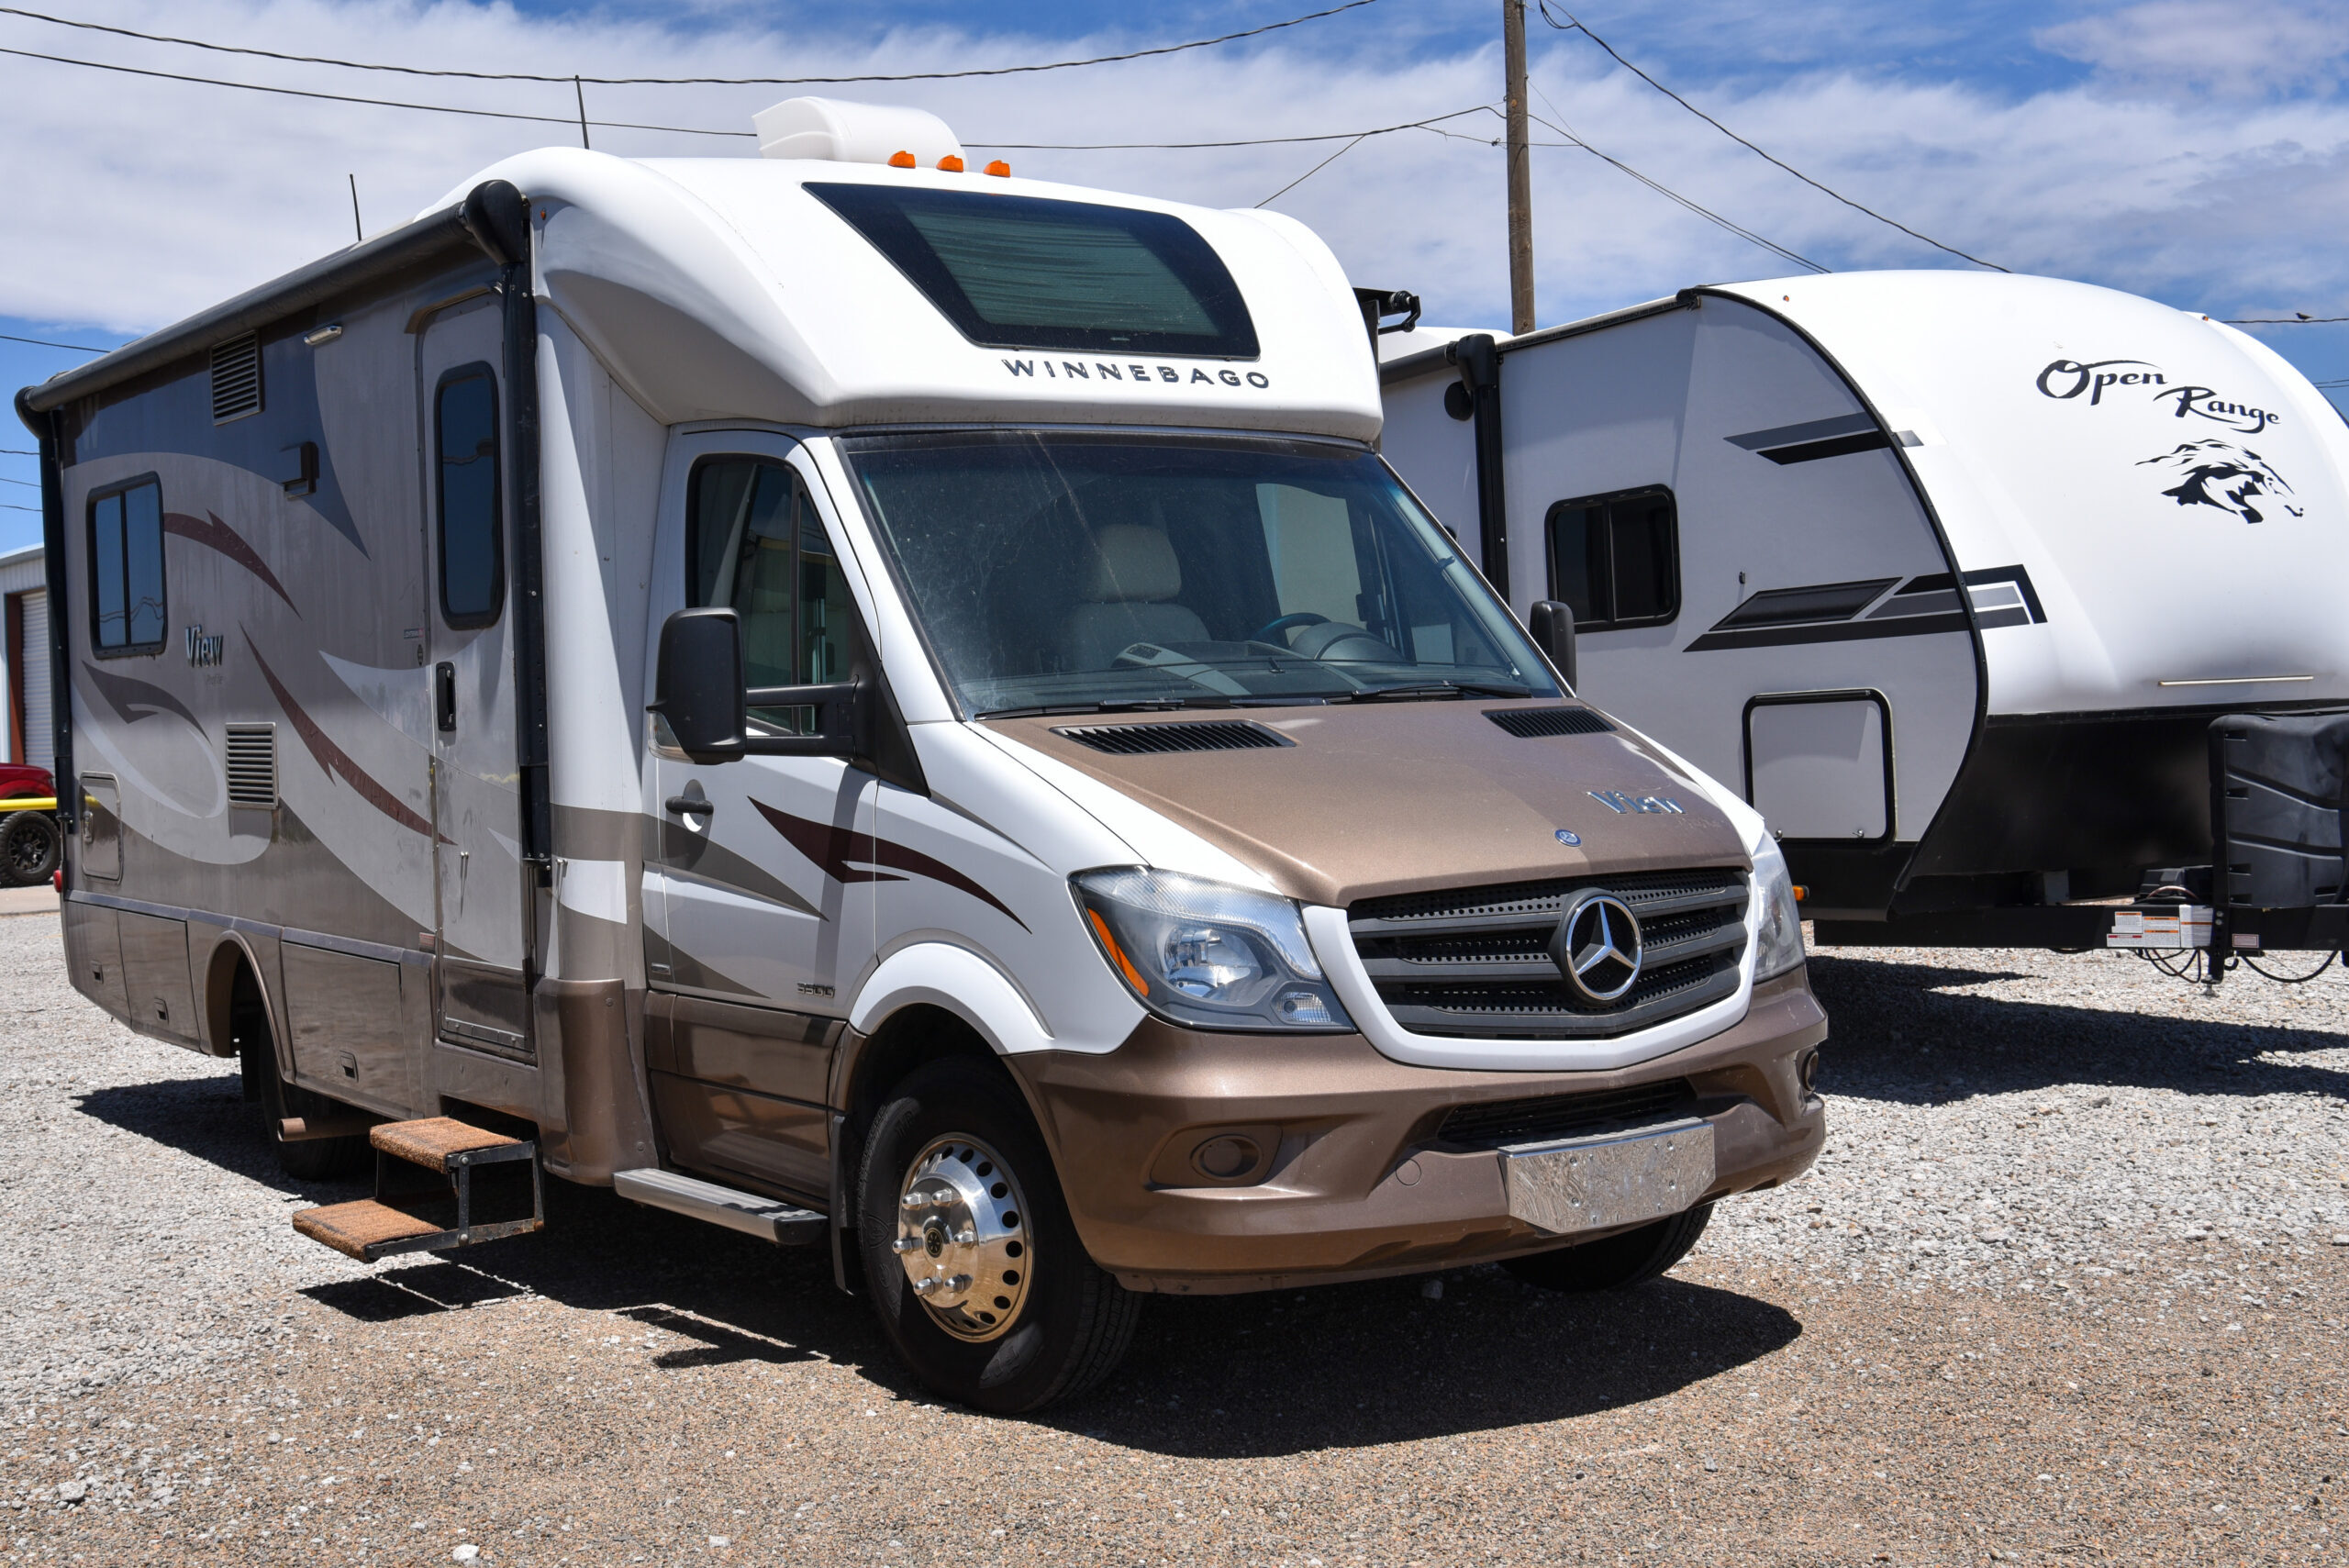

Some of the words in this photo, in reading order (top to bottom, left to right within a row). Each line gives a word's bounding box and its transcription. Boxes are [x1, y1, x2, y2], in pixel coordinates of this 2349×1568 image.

[1001, 359, 1270, 389] WINNEBAGO
[2036, 359, 2168, 406] Open
[2153, 385, 2281, 434] Range
[185, 624, 224, 668] View
[1586, 790, 1687, 814] View
